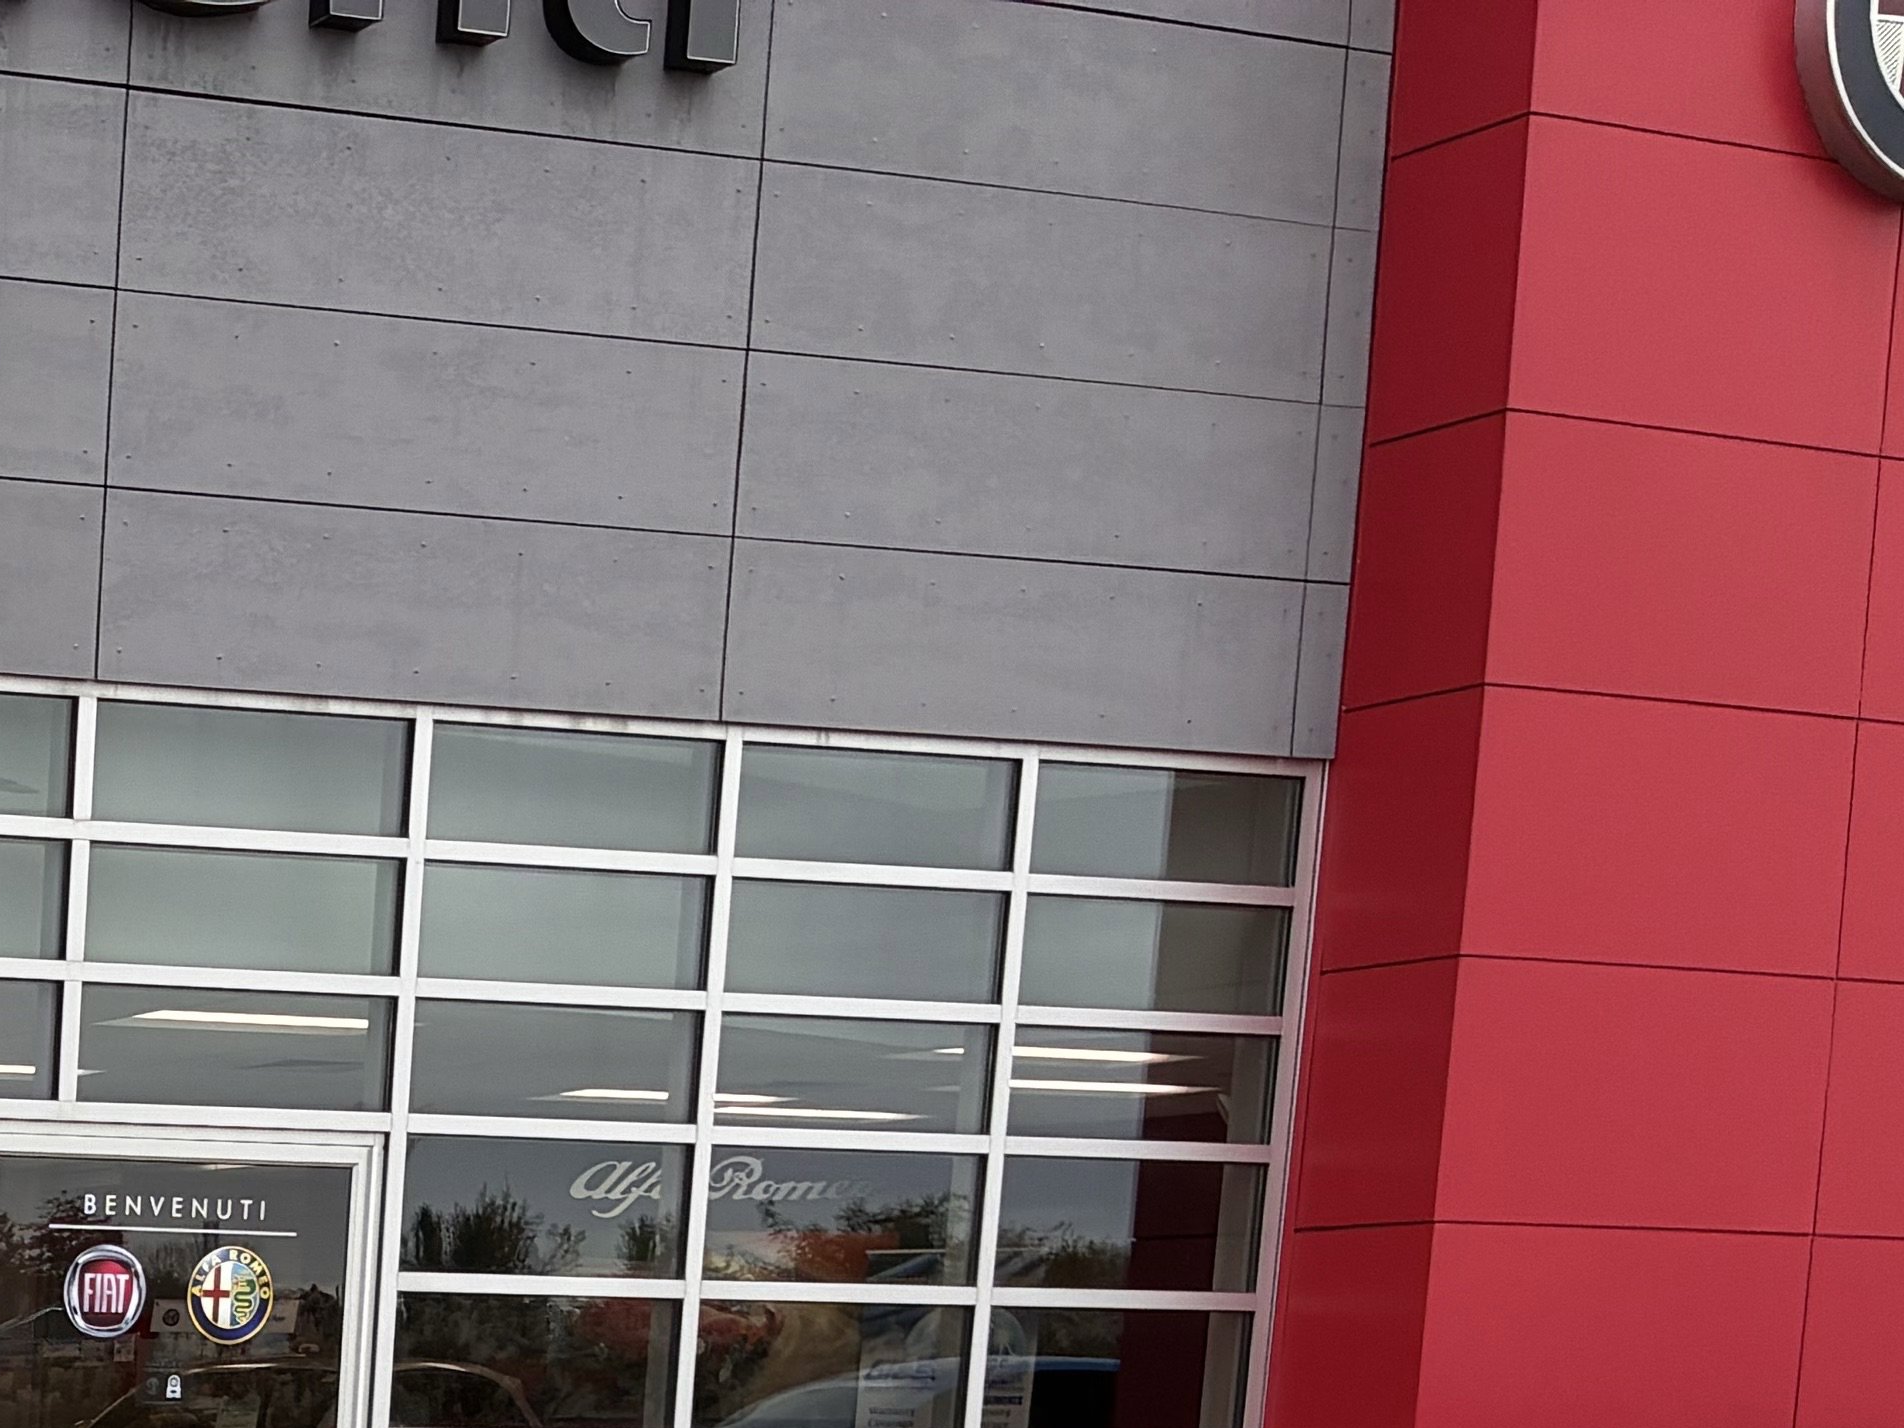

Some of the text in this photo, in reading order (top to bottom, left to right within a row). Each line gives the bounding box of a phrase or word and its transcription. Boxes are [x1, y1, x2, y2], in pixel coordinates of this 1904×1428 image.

[83, 1194, 267, 1221] BENVENUTI
[569, 1160, 662, 1219] Alf
[83, 1272, 130, 1314] FIAT
[191, 1249, 271, 1299] ALFA ROMEO
